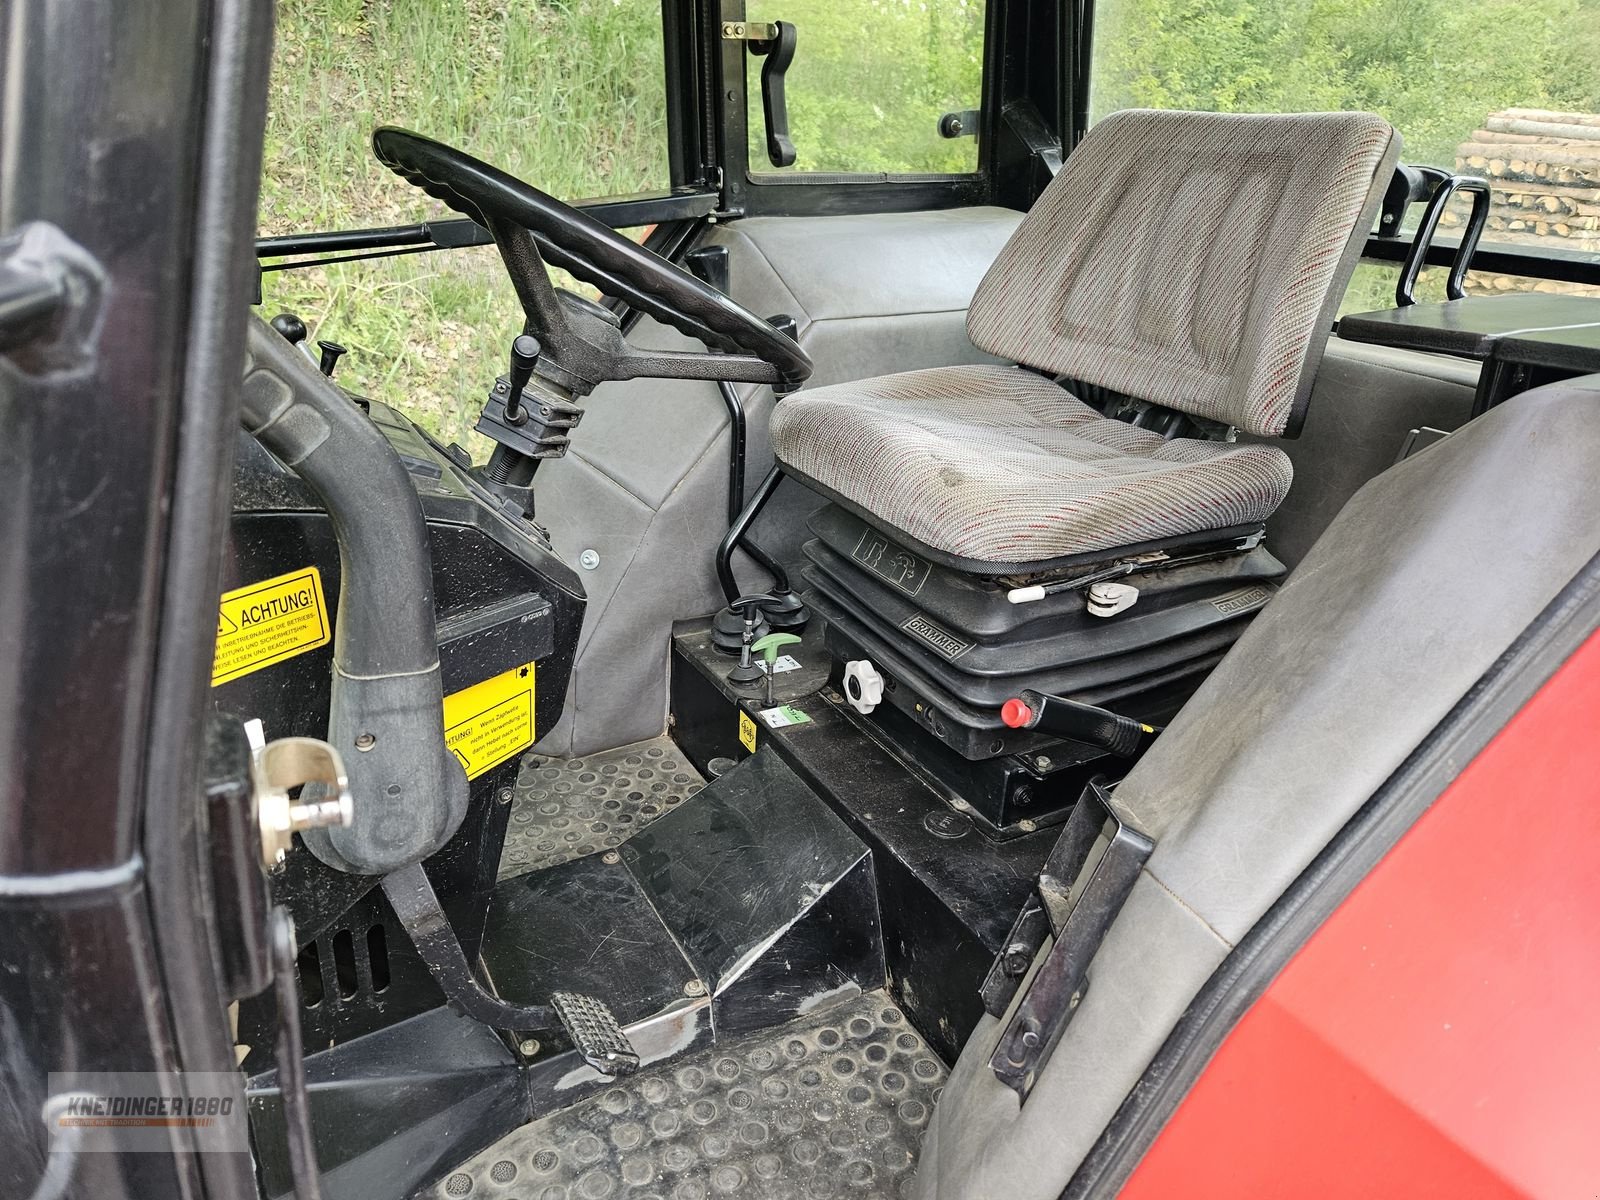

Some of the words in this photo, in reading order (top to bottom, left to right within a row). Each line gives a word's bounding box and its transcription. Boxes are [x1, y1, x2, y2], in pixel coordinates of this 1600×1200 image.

[241, 588, 313, 627] ACHTUNG!
[1218, 590, 1266, 612] GRAMMER
[276, 622, 286, 630] DIE
[910, 620, 961, 655] GRAMMER
[215, 646, 245, 660] NLEITUNG
[246, 642, 259, 650] UND
[232, 653, 252, 664] LESEN
[253, 648, 267, 656] UND
[445, 727, 473, 746] HTUNG!
